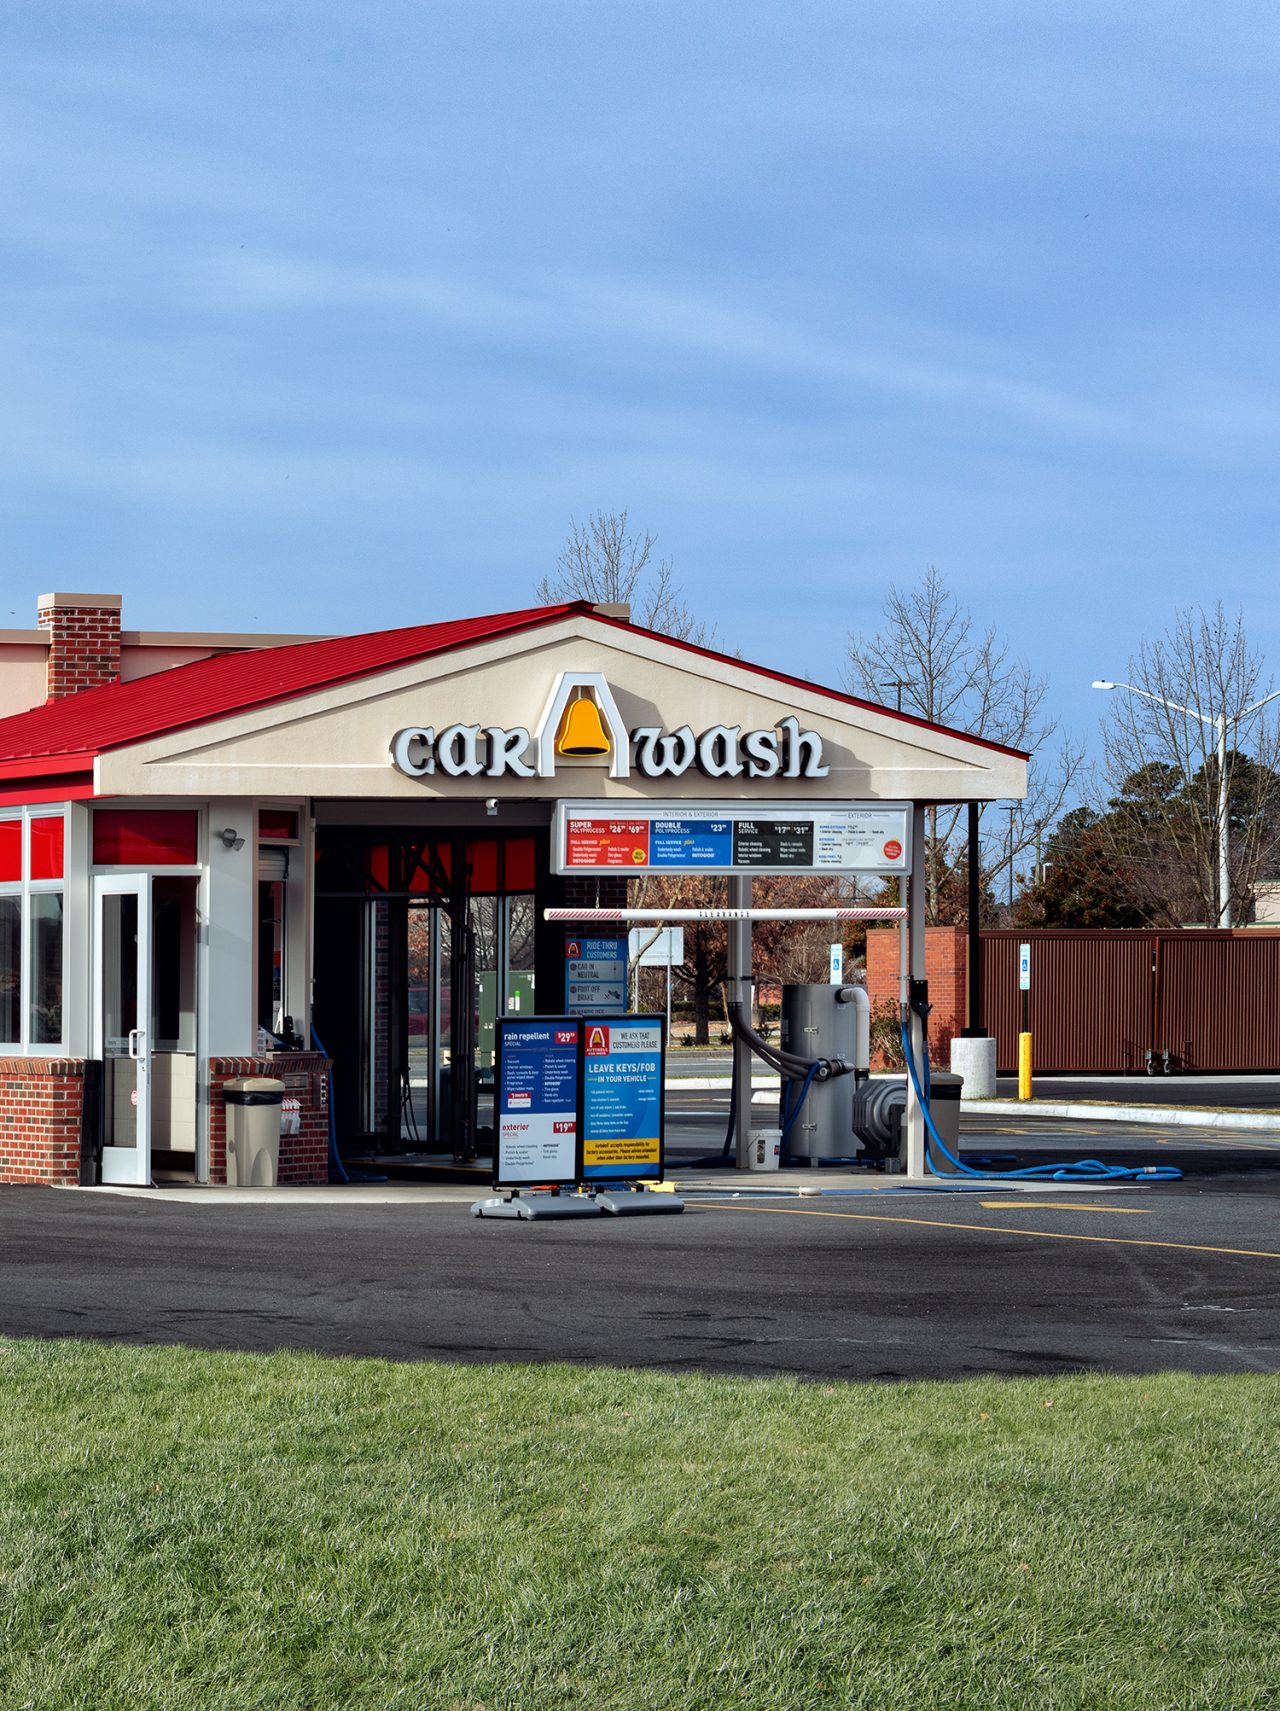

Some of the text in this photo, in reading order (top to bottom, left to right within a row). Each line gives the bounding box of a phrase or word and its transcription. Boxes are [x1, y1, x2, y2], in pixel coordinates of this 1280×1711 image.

[586, 941, 618, 950] RIDE-THRU
[586, 951, 617, 959] CUSTOMERS
[504, 1032, 518, 1040] rain
[519, 1032, 550, 1041] repellent
[613, 1041, 640, 1049] CUSTOMERS
[589, 1062, 656, 1073] LEAVE KEYS/FOB
[502, 1123, 529, 1131] exterior
